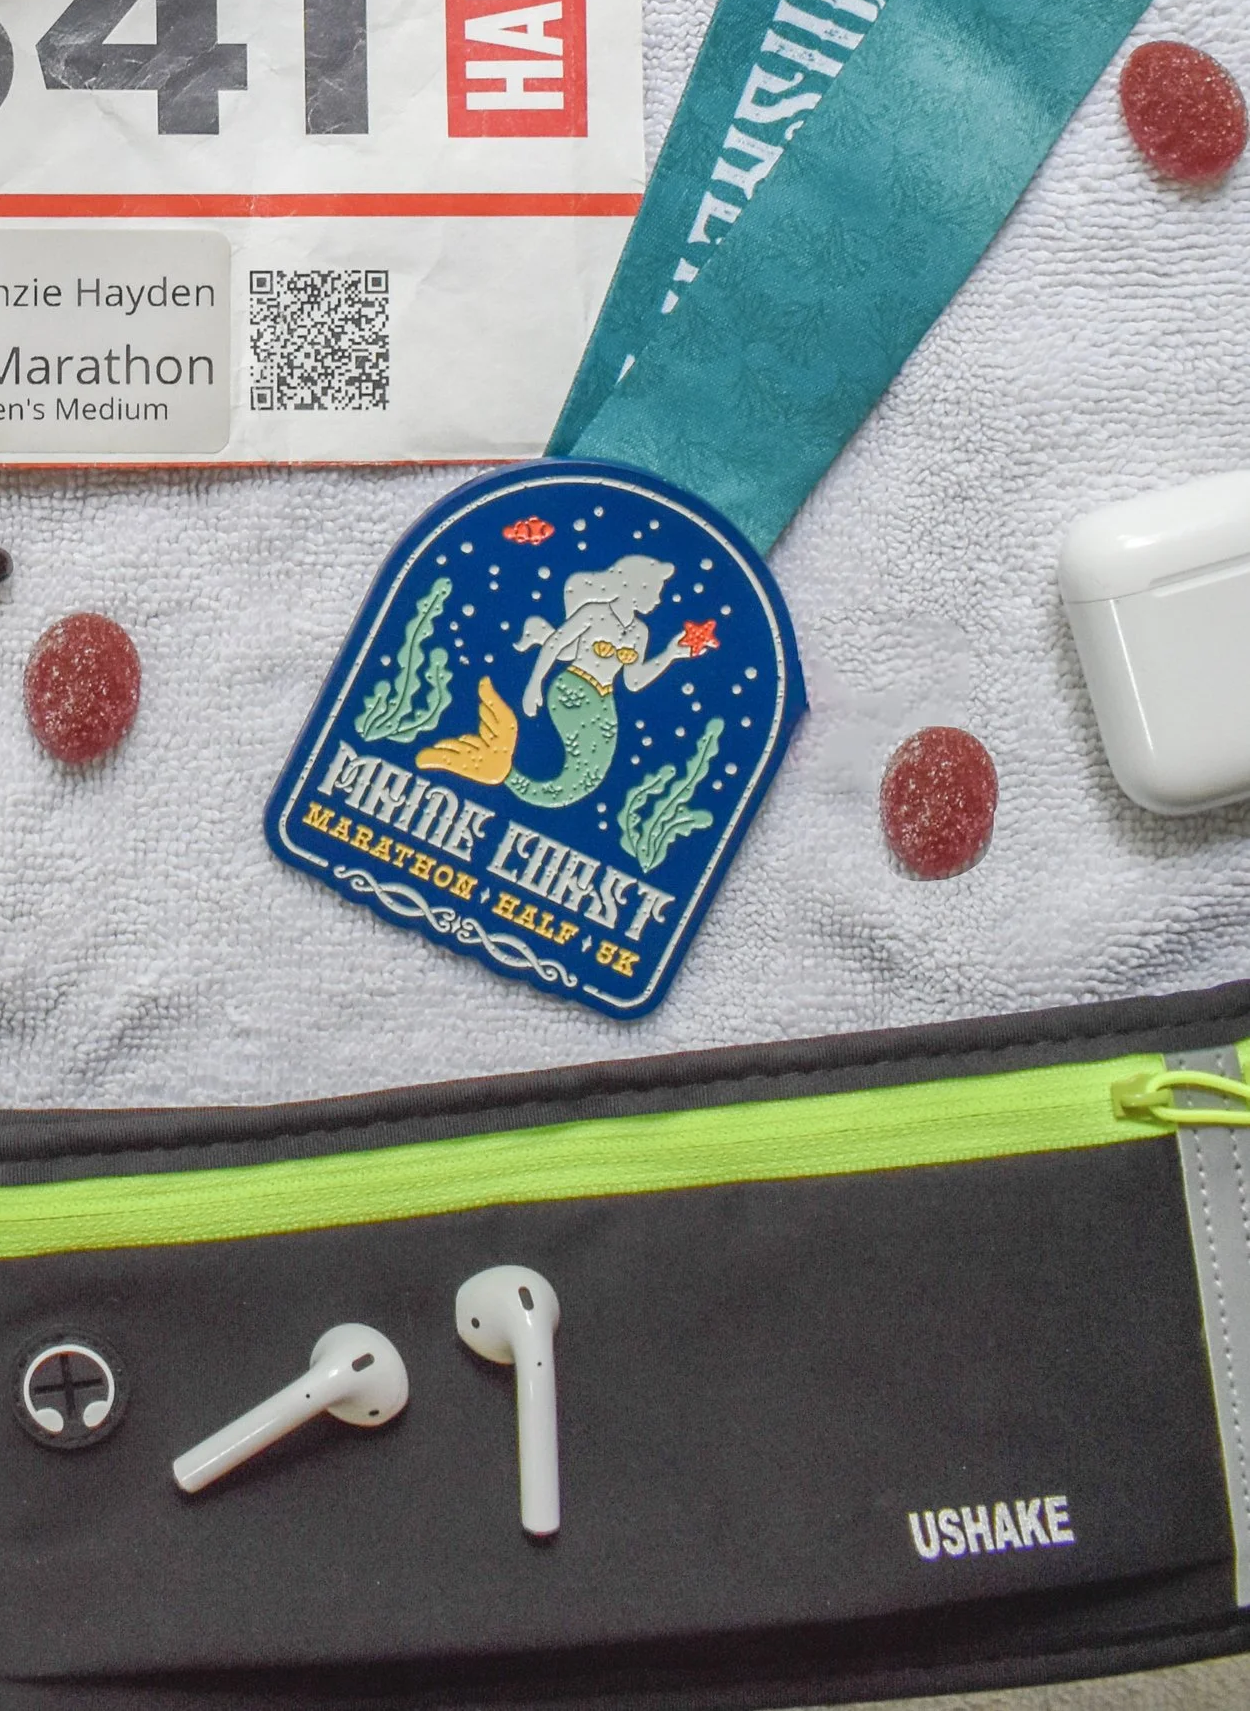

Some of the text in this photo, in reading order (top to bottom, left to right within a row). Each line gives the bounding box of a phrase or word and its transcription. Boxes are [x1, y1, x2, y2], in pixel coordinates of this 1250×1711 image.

[76, 275, 216, 316] Hayden
[55, 396, 169, 422] Medium
[316, 740, 675, 942] MAINE COAST
[302, 801, 643, 978] MARATHON HALF 5K
[907, 1494, 1076, 1560] USHAKE
